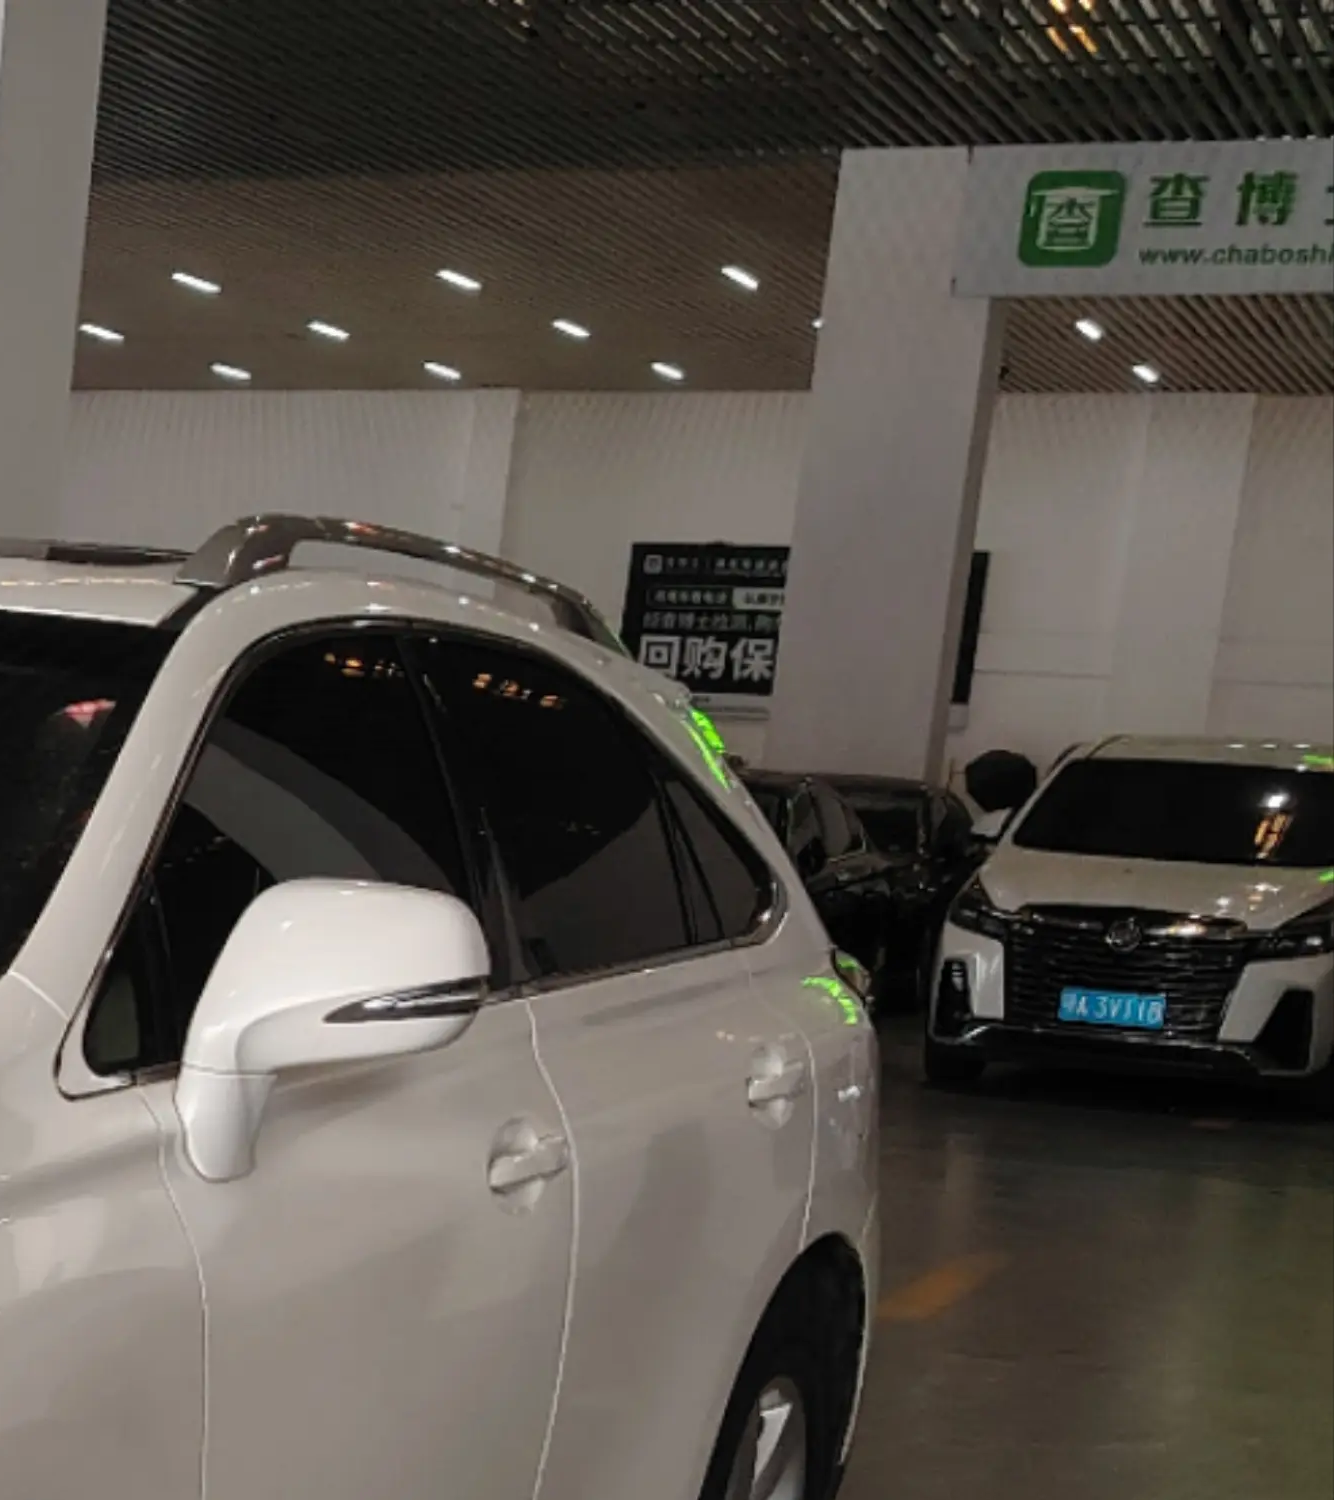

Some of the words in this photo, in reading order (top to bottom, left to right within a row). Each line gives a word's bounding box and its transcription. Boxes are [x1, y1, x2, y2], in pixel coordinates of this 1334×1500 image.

[1143, 172, 1333, 227] 查博
[638, 635, 775, 683] 回购保
